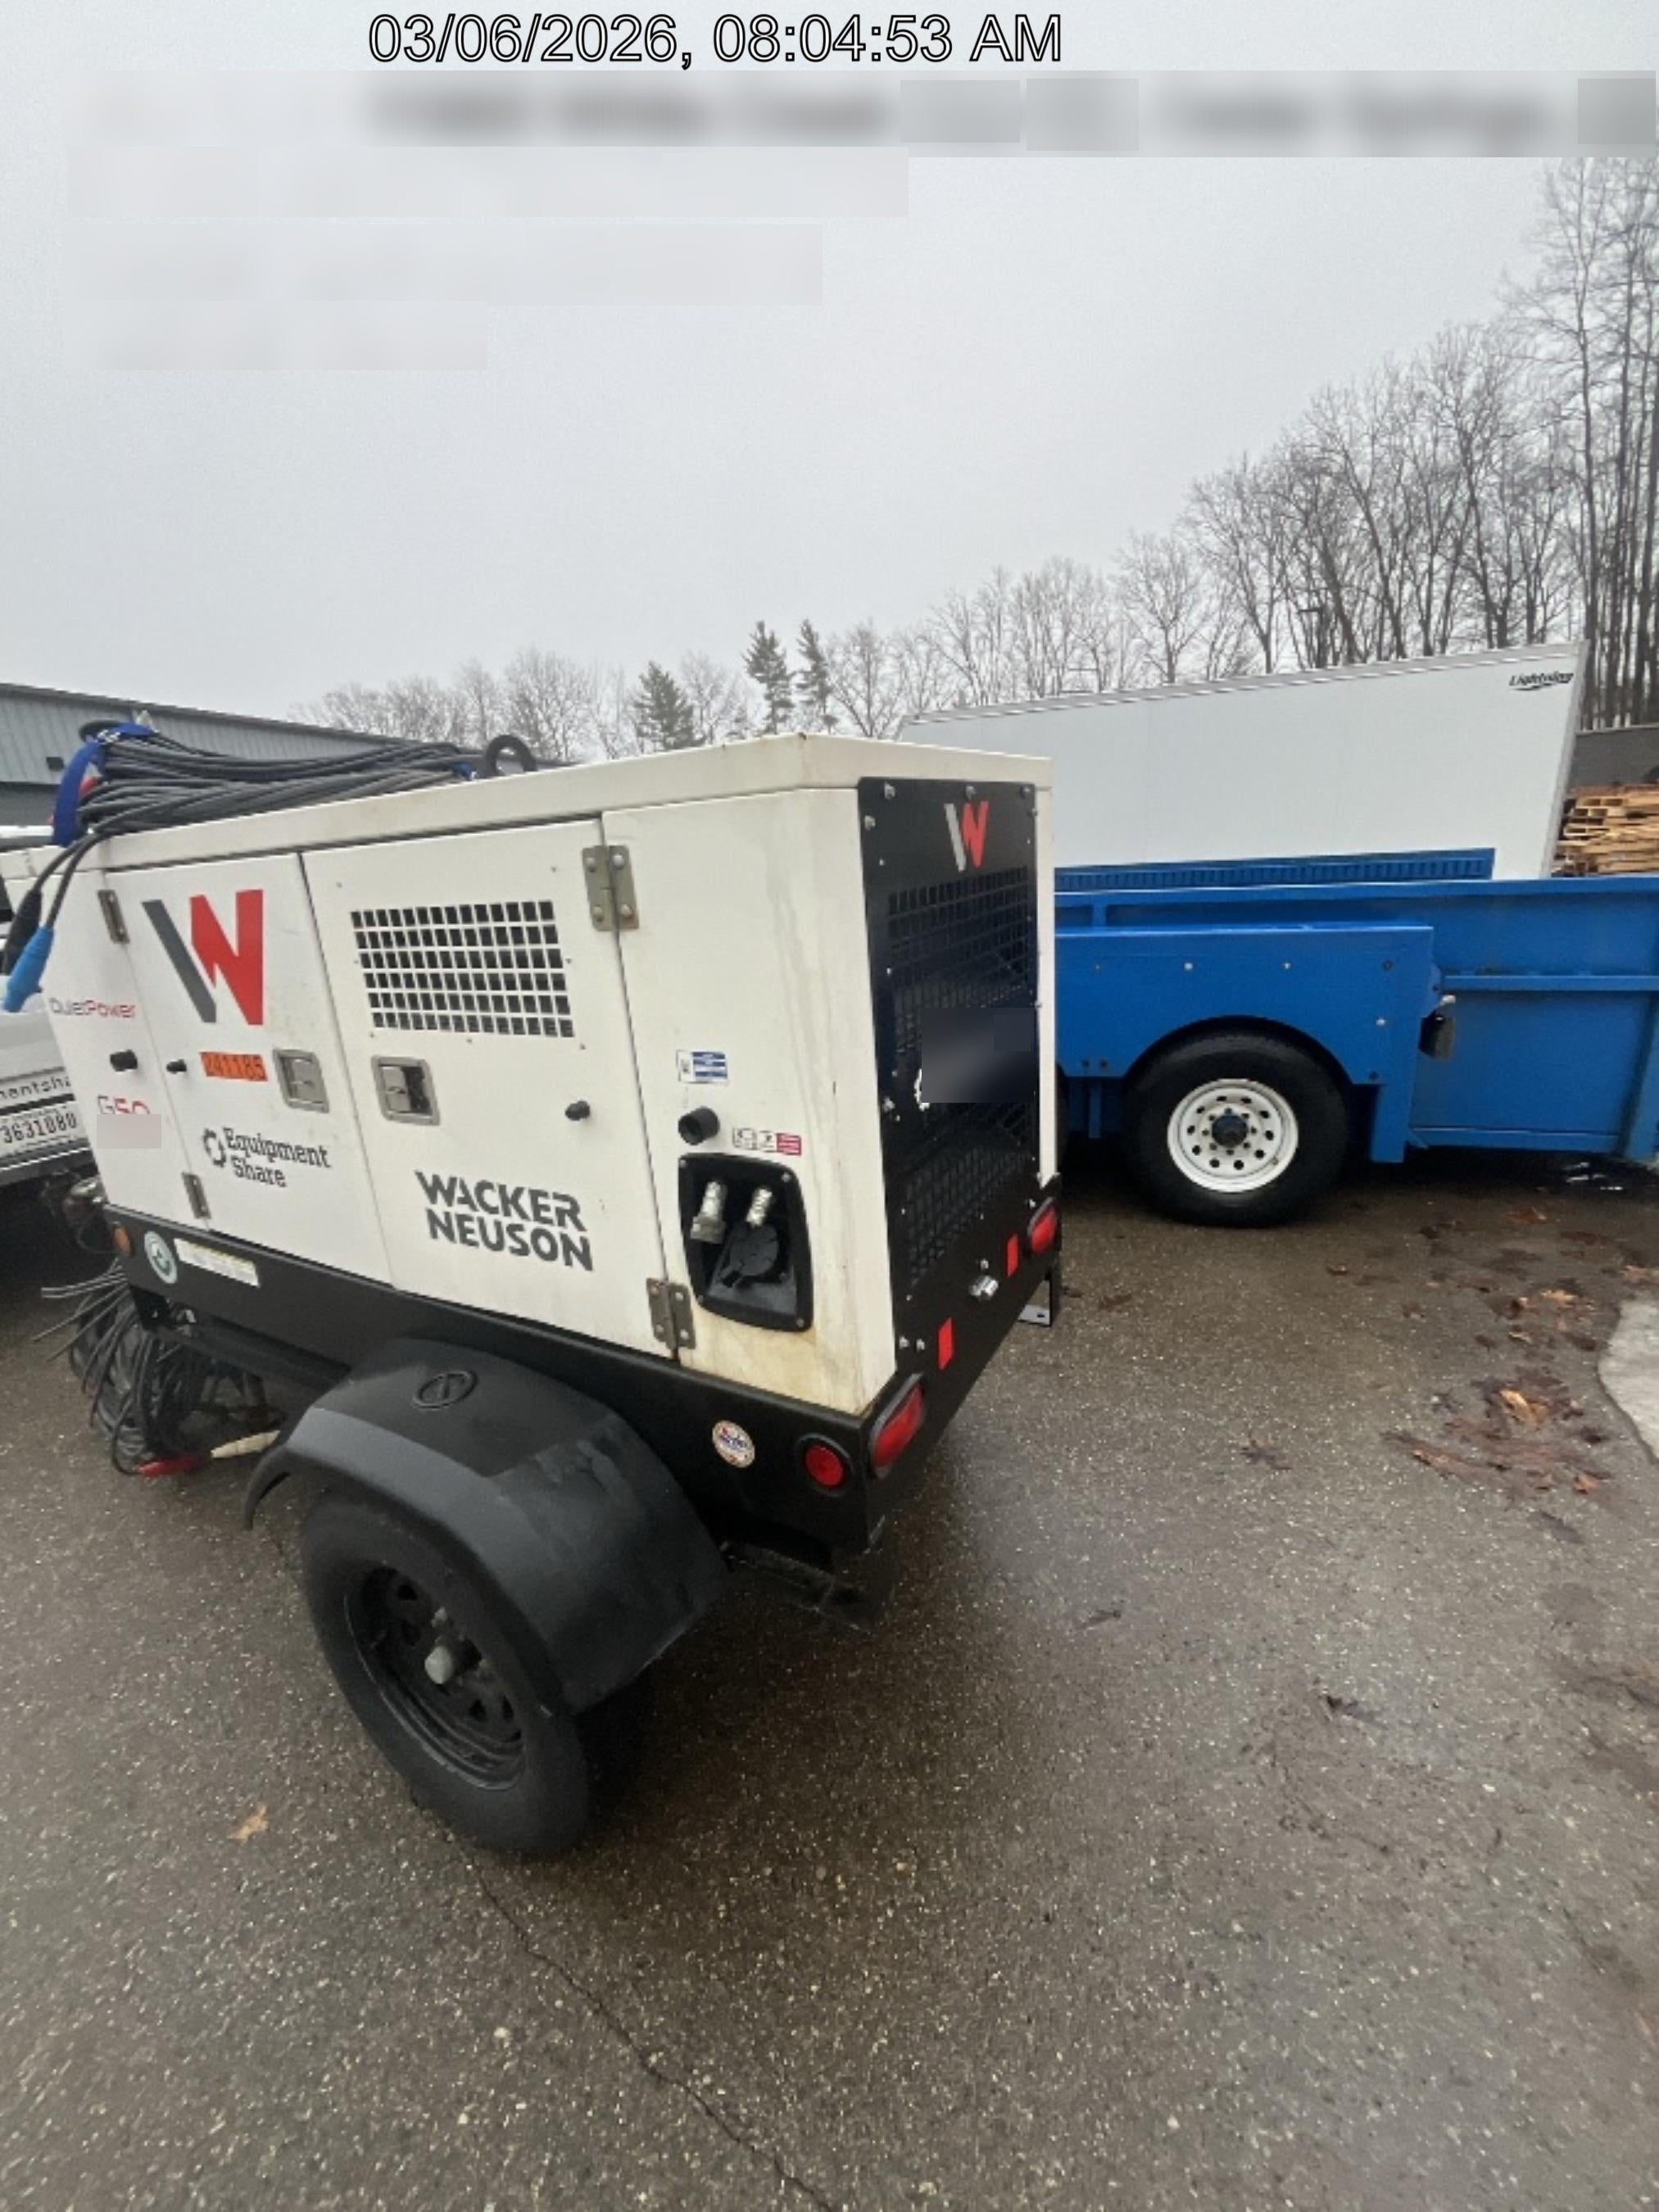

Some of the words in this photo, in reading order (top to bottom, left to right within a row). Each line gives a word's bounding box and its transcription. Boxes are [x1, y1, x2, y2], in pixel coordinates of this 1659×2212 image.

[222, 1126, 332, 1169] Equipment
[231, 1155, 288, 1187] Share
[414, 1169, 588, 1232] WACKER
[424, 1207, 594, 1271] NEUSON
